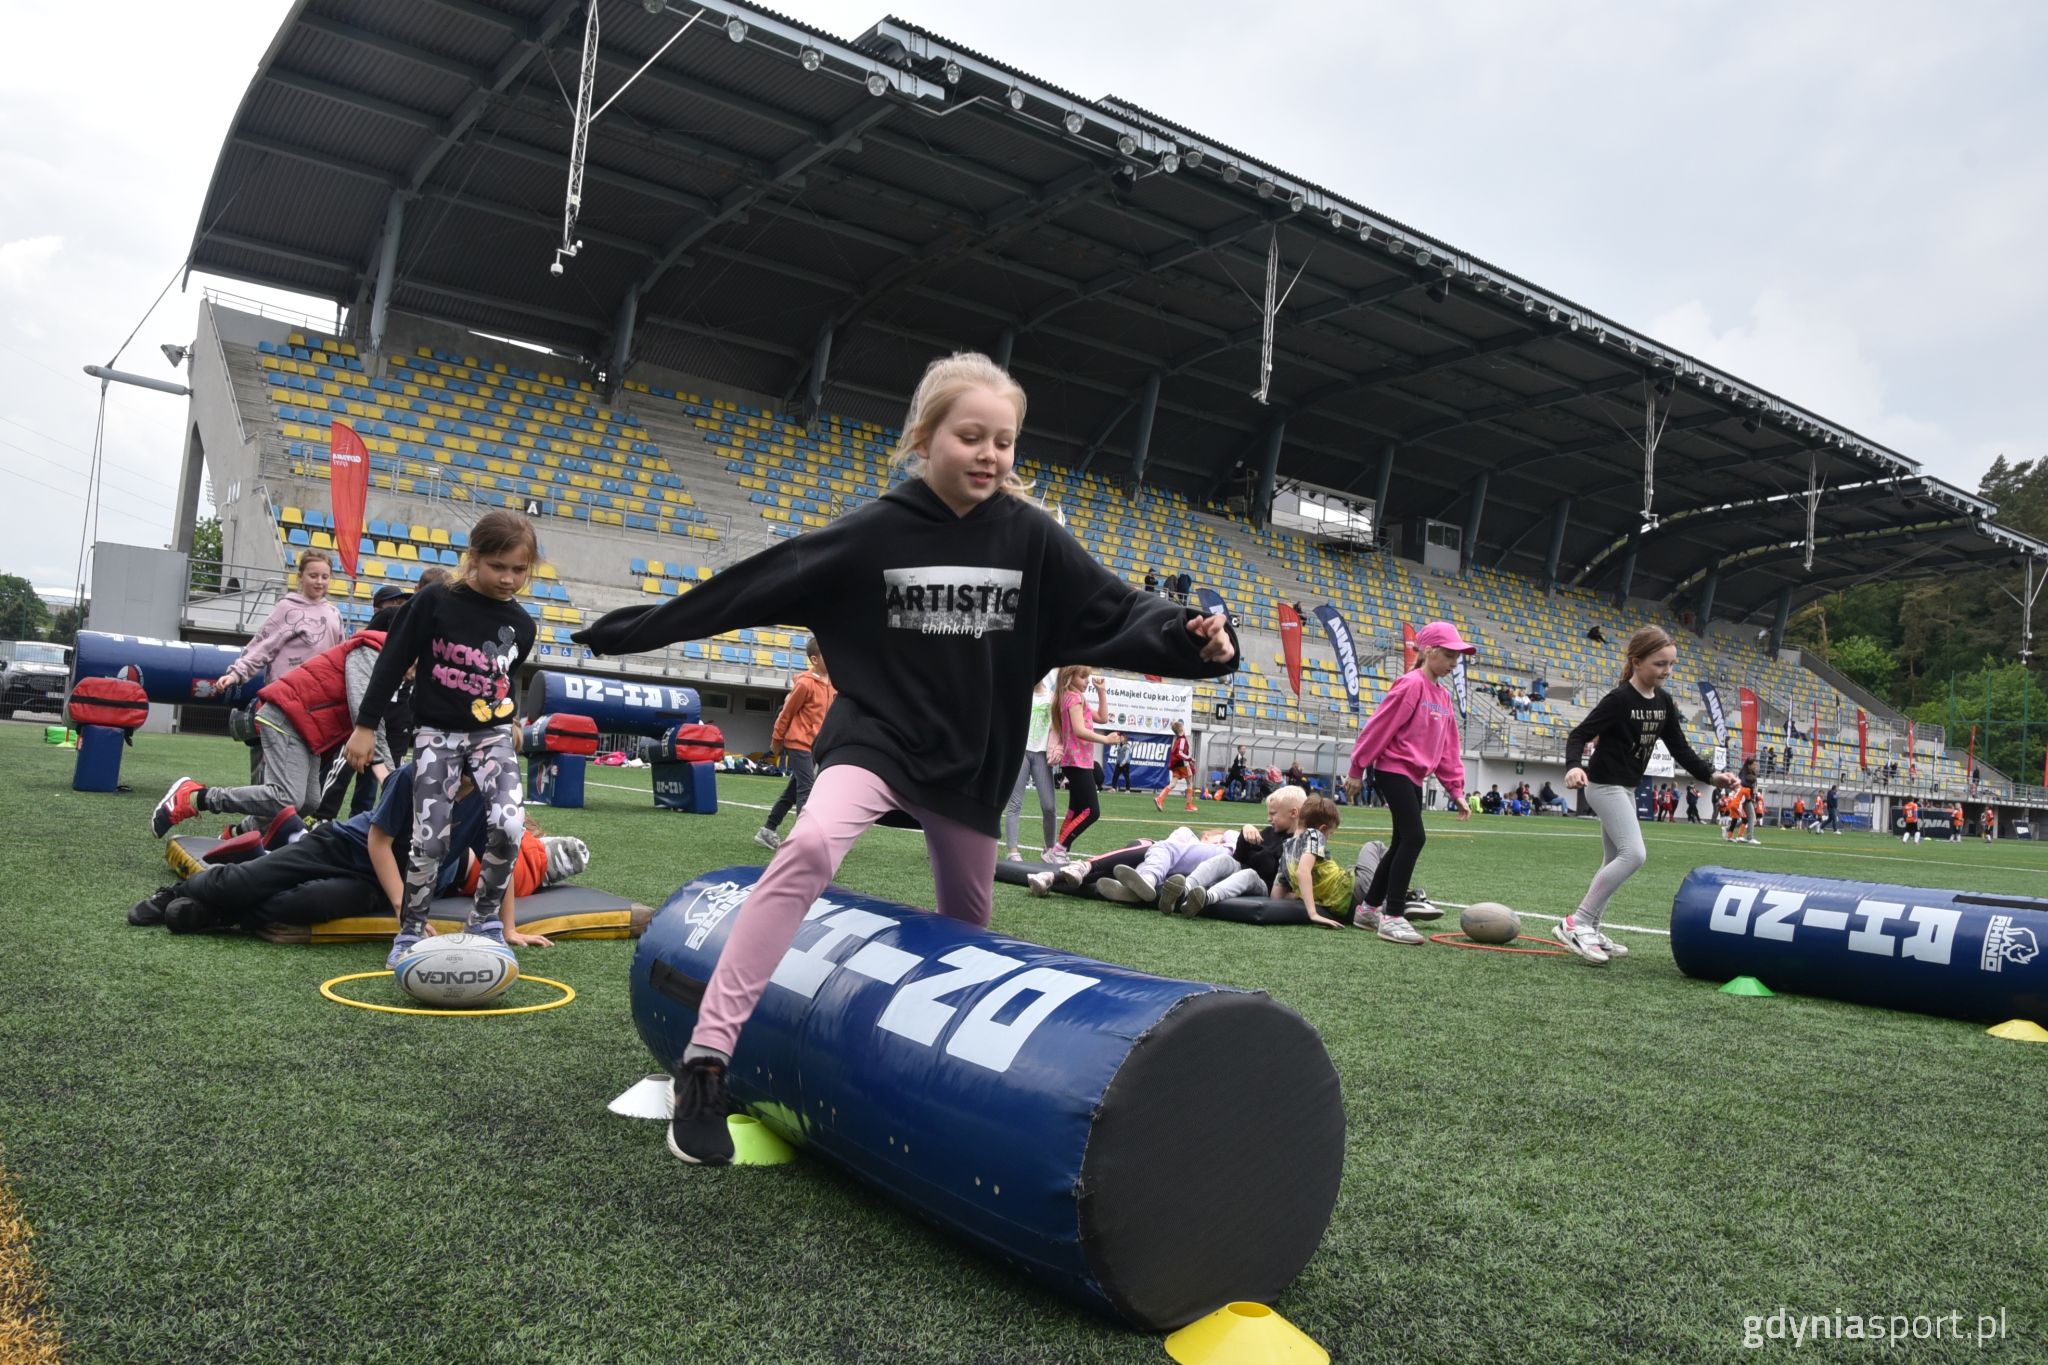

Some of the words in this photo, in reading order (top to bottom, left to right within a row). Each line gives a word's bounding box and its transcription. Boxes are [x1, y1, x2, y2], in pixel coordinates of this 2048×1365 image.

[527, 502, 538, 515] A
[886, 584, 1021, 614] ARTISTIC
[921, 622, 984, 639] thinking
[432, 664, 495, 697] MOUSE
[564, 675, 663, 708] RHINO
[1143, 692, 1157, 701] Cup
[1218, 706, 1225, 718] N
[1630, 709, 1645, 720] ALL
[1109, 741, 1171, 761] einner
[1896, 818, 1950, 829] GYNIA
[687, 885, 757, 951] RHIN
[1709, 884, 1963, 965] RHINO
[1982, 914, 2011, 973] RHINO
[770, 897, 1101, 1073] HINO
